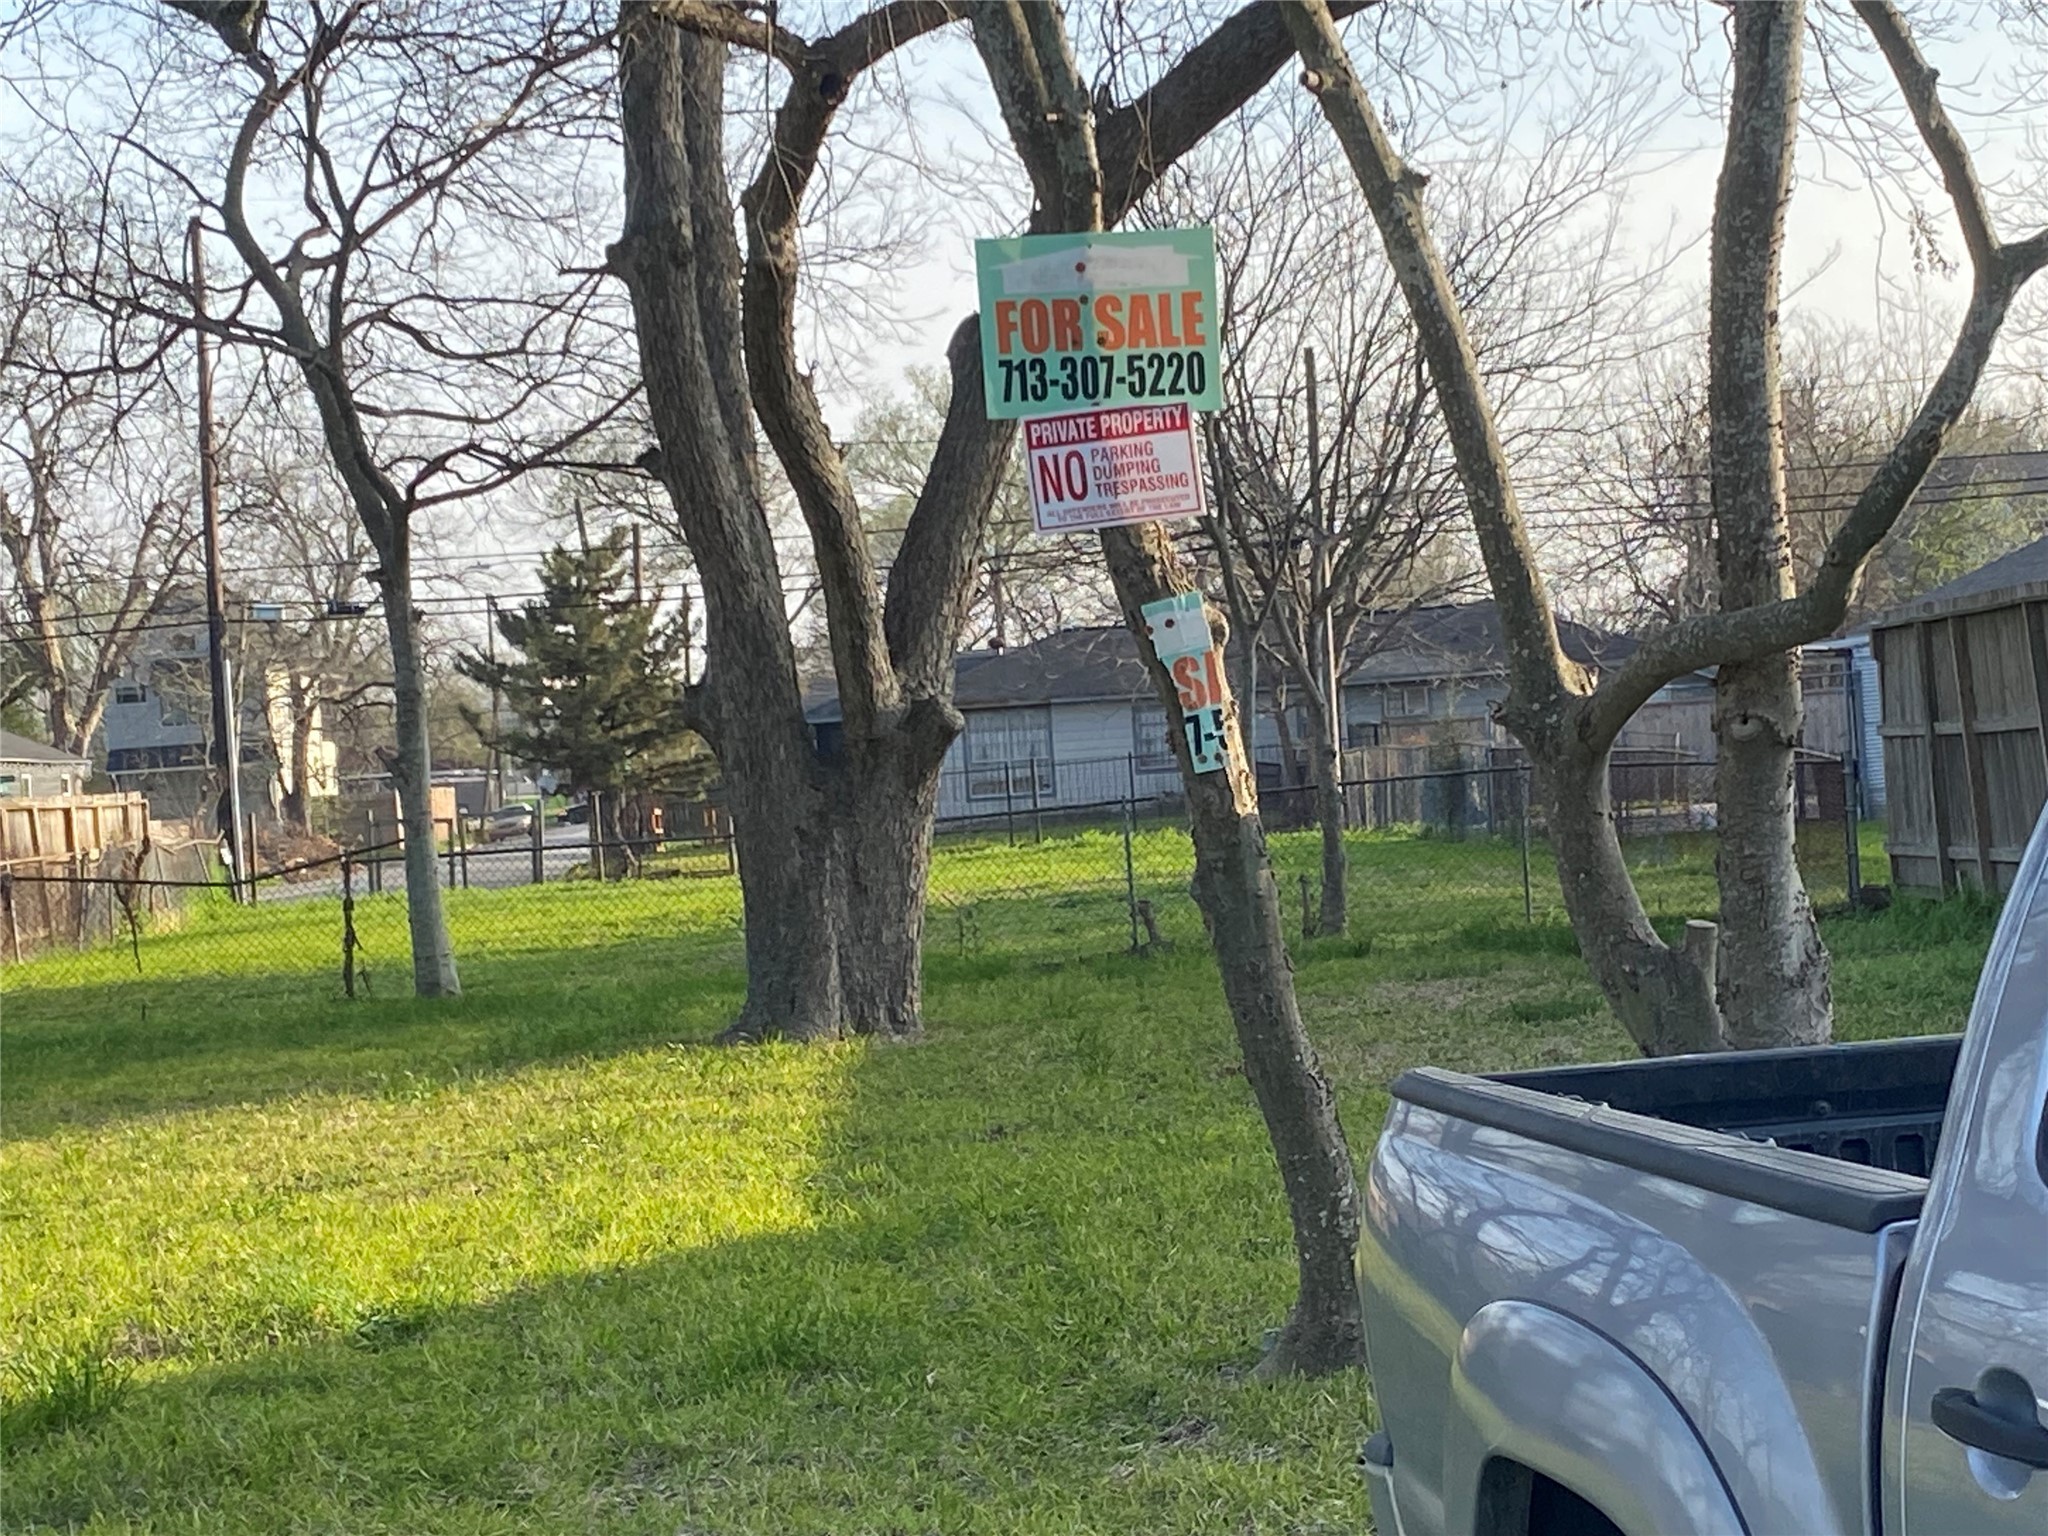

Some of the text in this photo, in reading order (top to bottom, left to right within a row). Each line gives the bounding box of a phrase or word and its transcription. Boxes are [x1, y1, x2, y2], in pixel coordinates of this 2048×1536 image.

[995, 292, 1206, 354] FOR SALE
[999, 351, 1206, 403] 713-307-5220
[1030, 405, 1183, 446] PRIVATE PROPERTY
[1091, 441, 1154, 463] PARKING
[1093, 458, 1161, 481] DUMPING
[1038, 450, 1088, 504] NO
[1095, 472, 1189, 498] TRESPASSING
